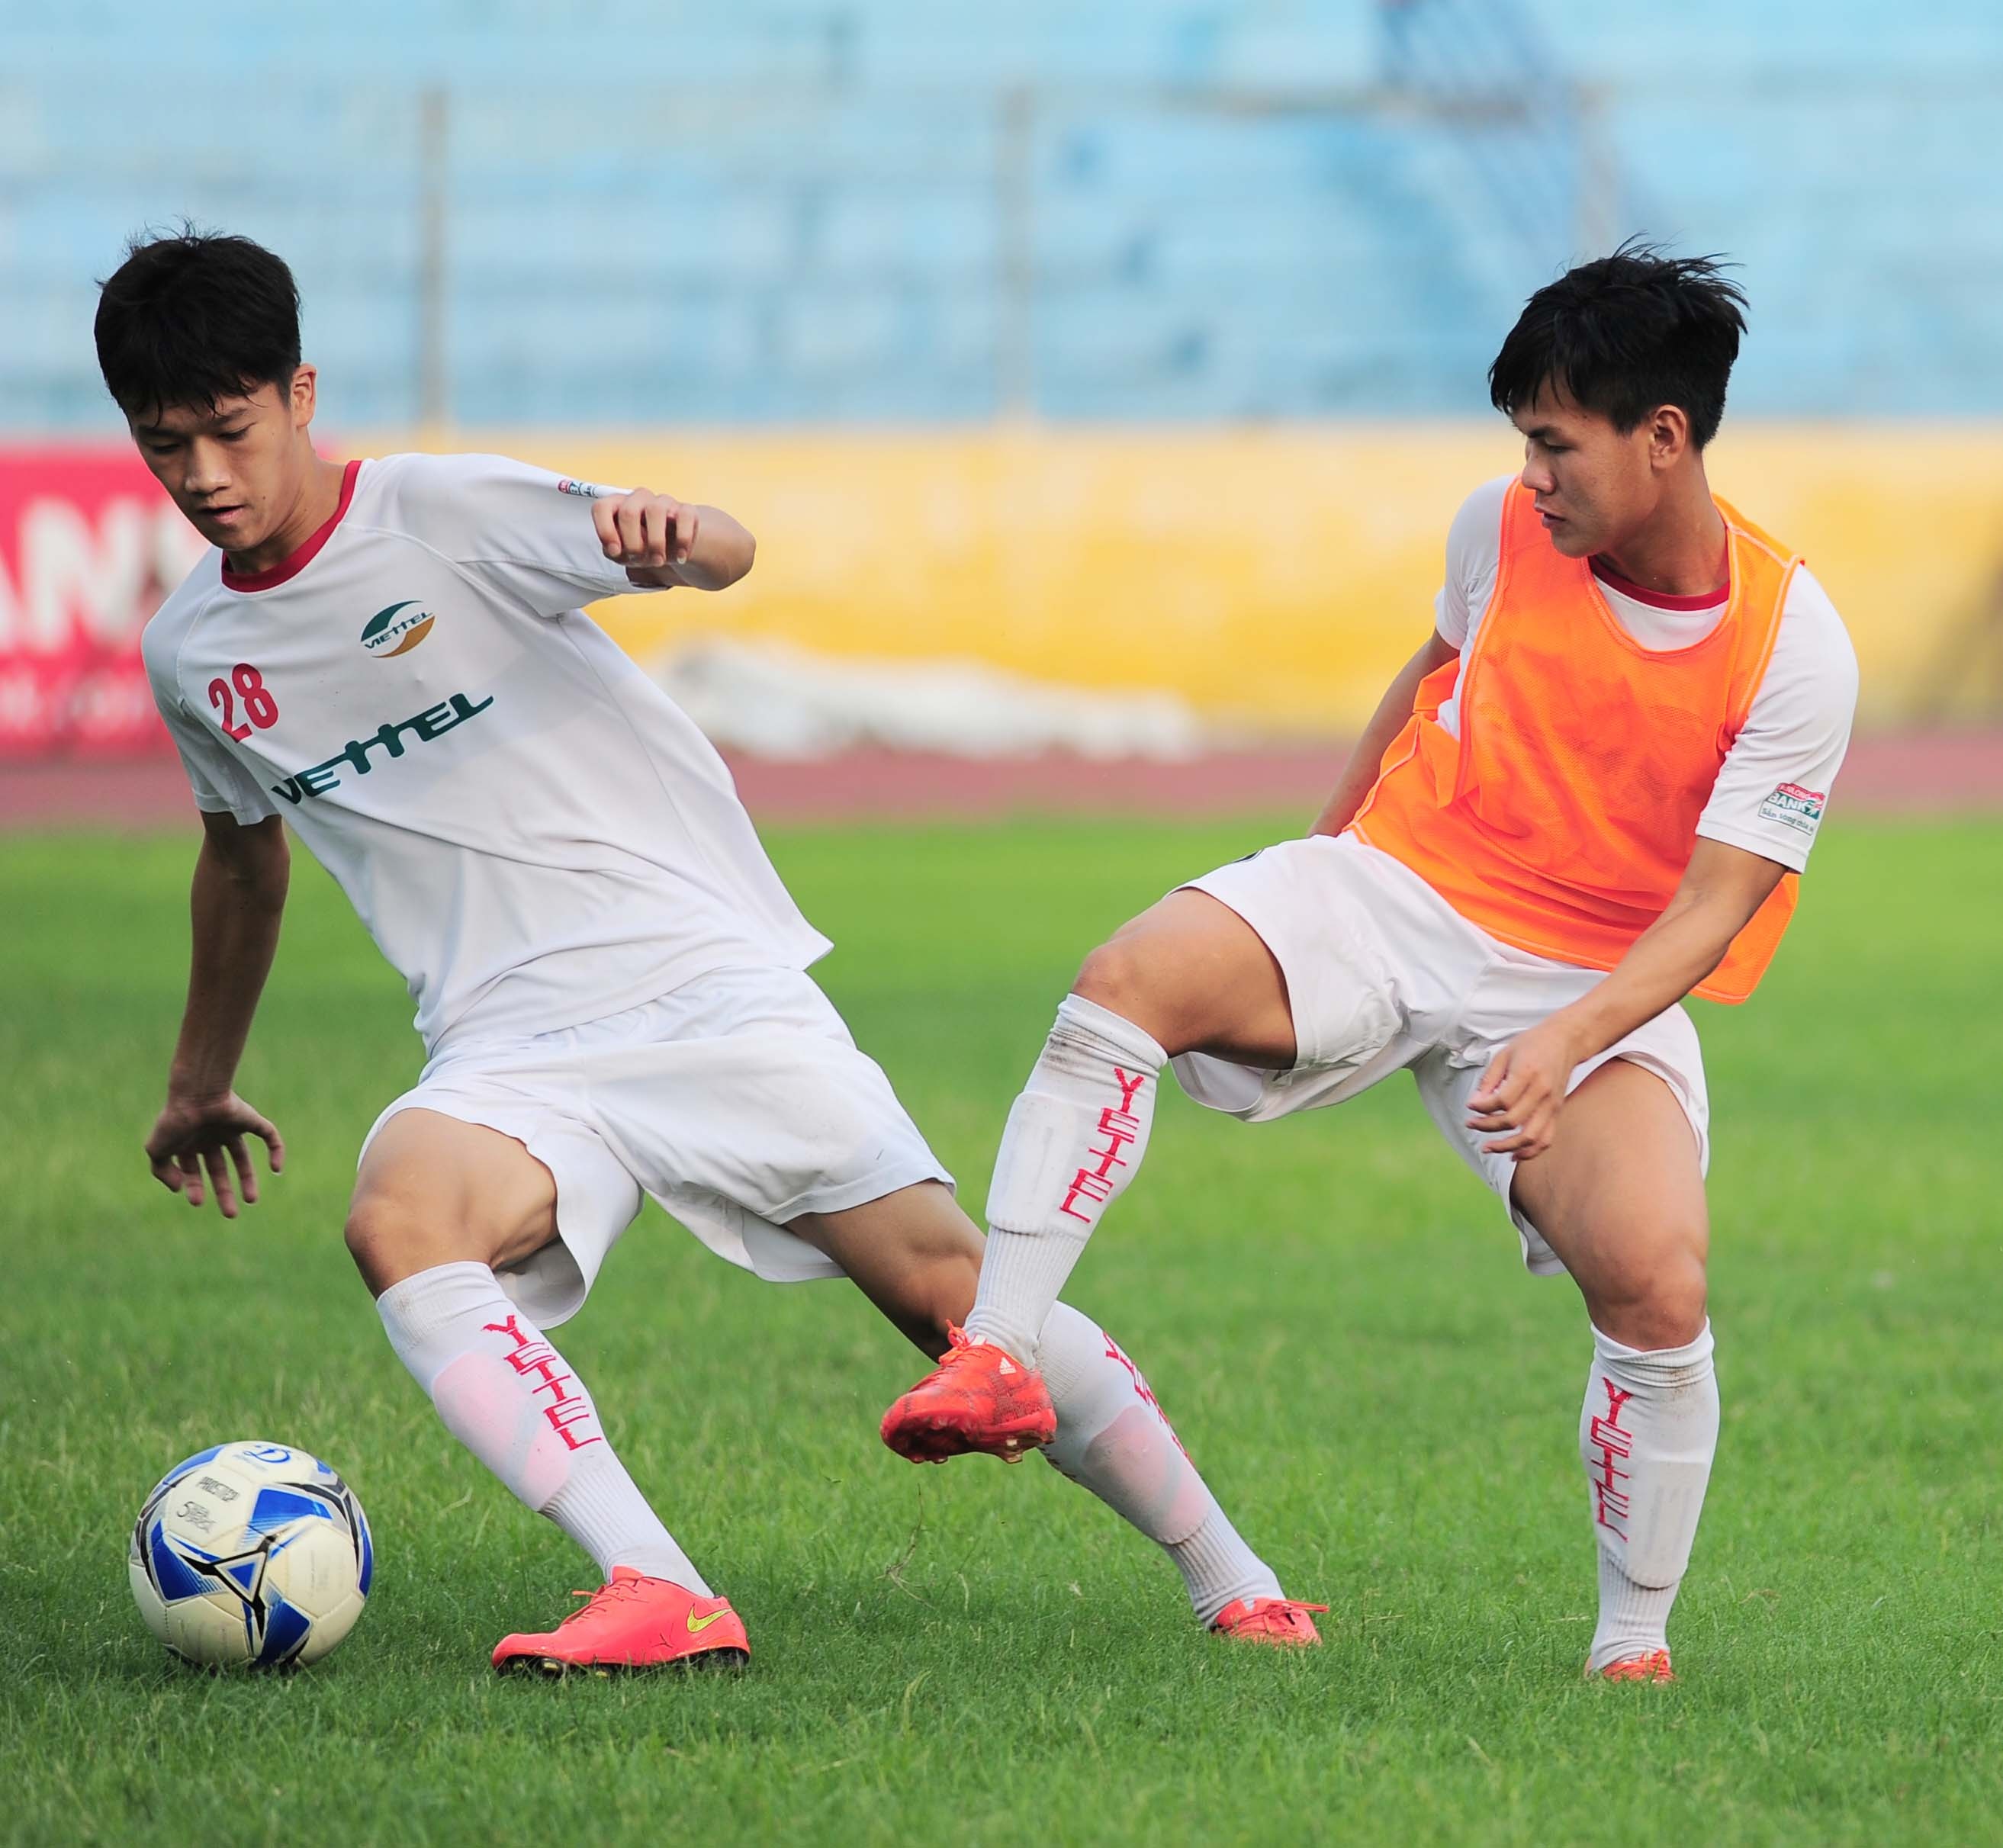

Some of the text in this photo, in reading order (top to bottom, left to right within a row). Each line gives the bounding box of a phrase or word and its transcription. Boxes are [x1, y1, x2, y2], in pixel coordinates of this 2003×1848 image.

[364, 612, 433, 648] VIETTEL
[208, 663, 279, 743] 28
[1767, 792, 1807, 813] BANK
